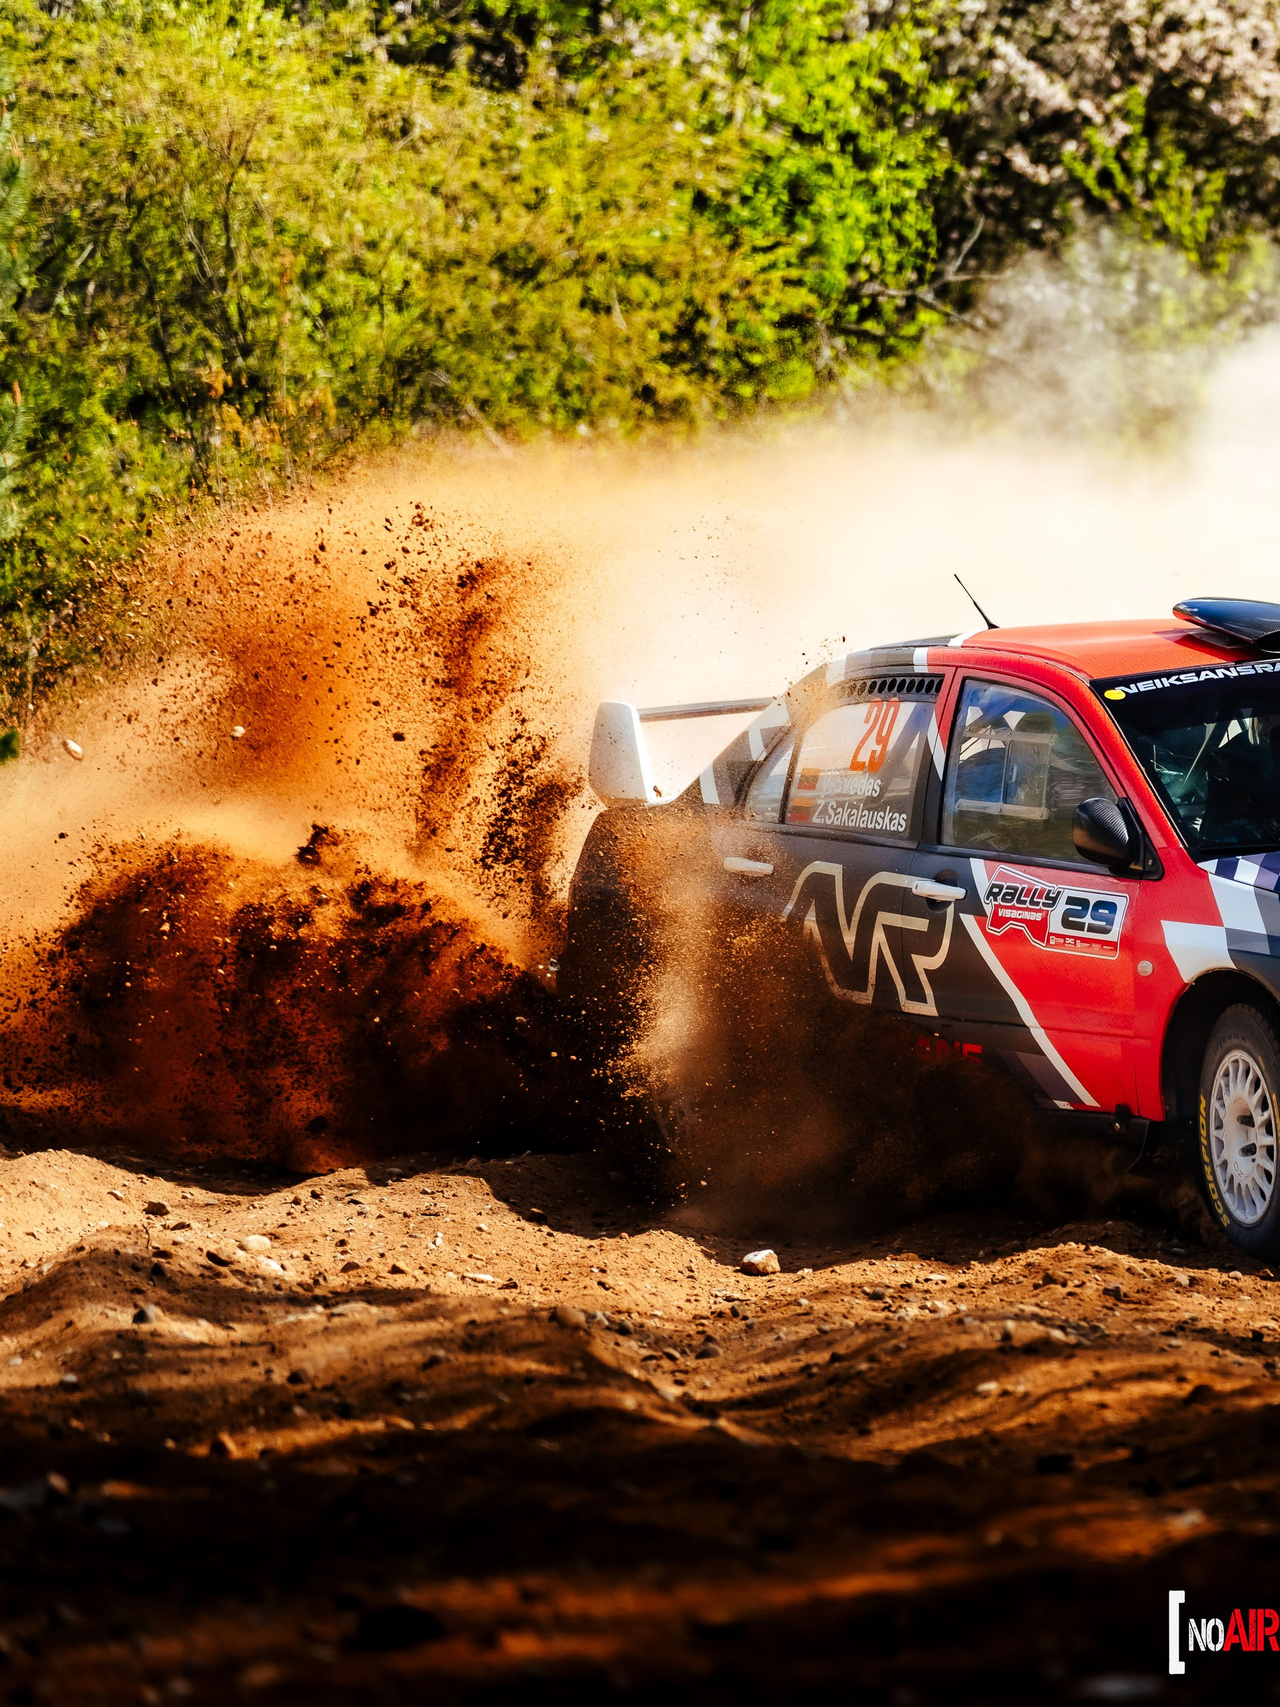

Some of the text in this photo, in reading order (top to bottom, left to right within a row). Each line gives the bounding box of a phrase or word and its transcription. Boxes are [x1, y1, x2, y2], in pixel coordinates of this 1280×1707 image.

[849, 697, 901, 774] 29
[812, 800, 907, 832] Z.Sakalauskas
[1061, 895, 1118, 935] 29
[1200, 1093, 1231, 1228] SCORPION
